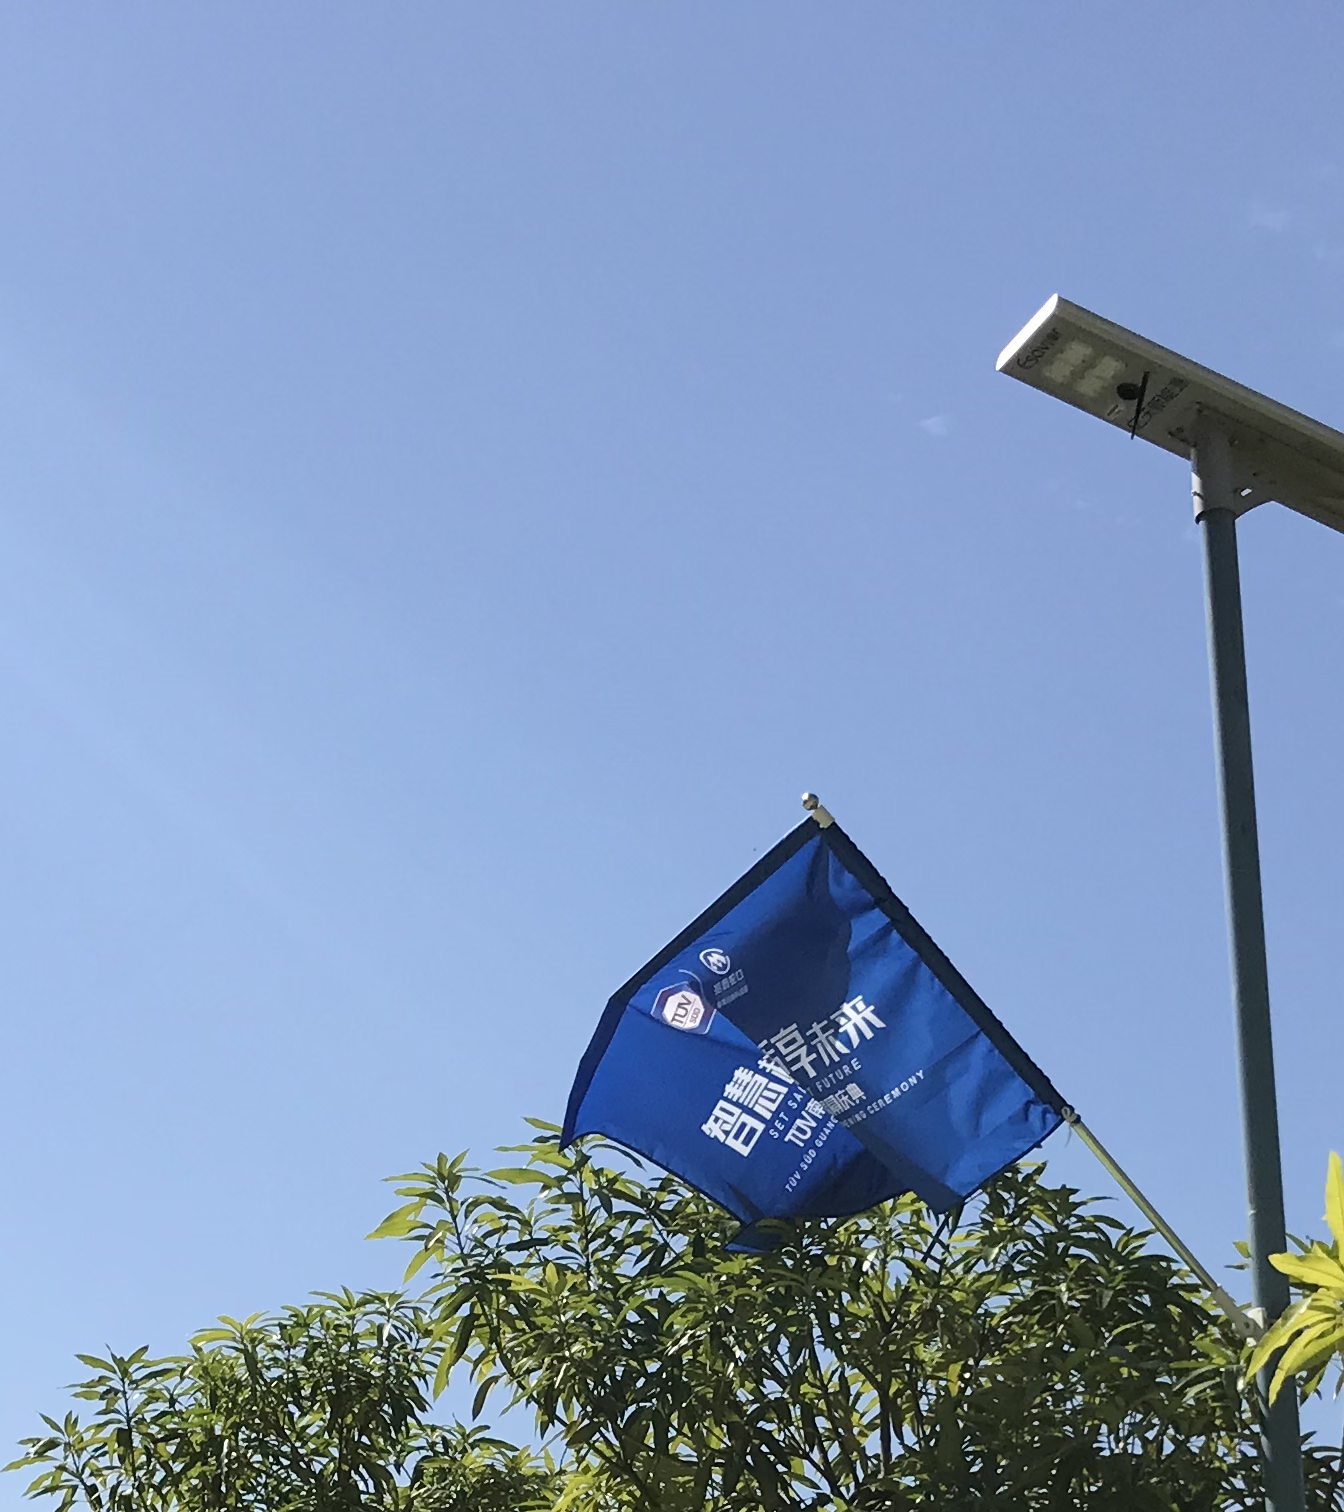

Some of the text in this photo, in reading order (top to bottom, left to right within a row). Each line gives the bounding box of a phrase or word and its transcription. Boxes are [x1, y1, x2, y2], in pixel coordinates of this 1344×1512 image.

[768, 1111, 789, 1139] SET
[815, 1057, 862, 1093] FUTURE
[866, 1069, 925, 1115] CEREMONY
